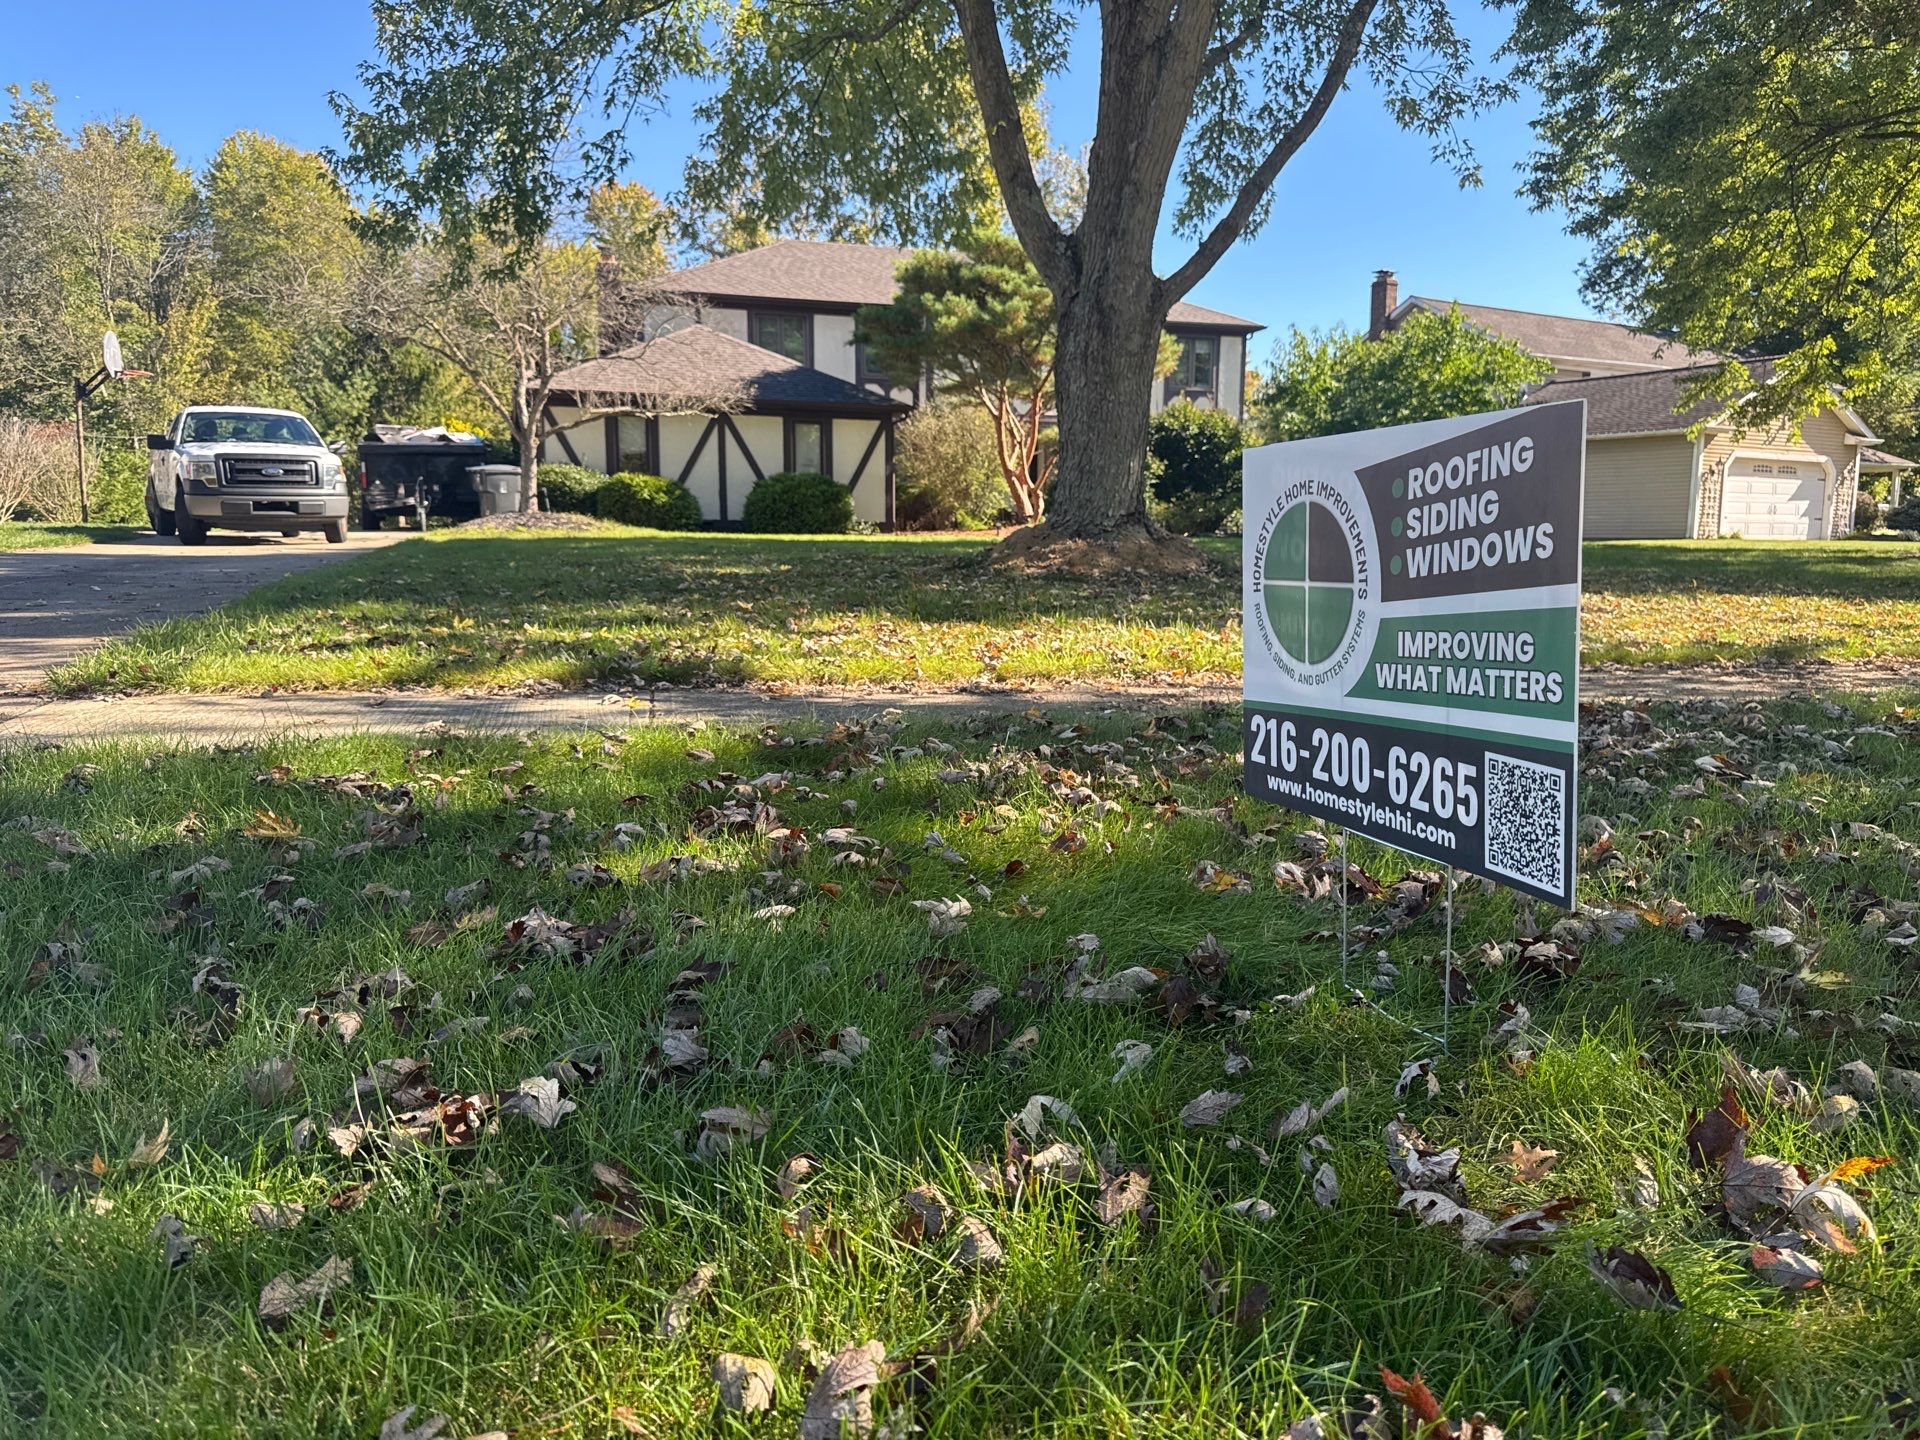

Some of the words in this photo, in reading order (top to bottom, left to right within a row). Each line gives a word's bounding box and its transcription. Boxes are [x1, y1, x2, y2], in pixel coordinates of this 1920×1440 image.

[1407, 436, 1534, 500] ROOFING
[1253, 496, 1285, 593] HOMESTYLE
[1284, 480, 1314, 504] HOME
[1316, 481, 1368, 600] IMPROVEMENTS
[1406, 490, 1499, 539] SIDING
[1406, 523, 1554, 579] WINDOWS
[1254, 603, 1273, 655] ROOFING,
[1273, 652, 1296, 682] SIDING,
[1298, 673, 1313, 686] AND
[1315, 660, 1344, 686] GUTTER
[1341, 610, 1366, 665] SYSTEMS
[1397, 631, 1535, 663] IMPROVING
[1375, 662, 1442, 691] WHAT
[1446, 667, 1563, 703] MATTERS
[1250, 714, 1479, 827] 216-200-6265
[1267, 775, 1456, 850] www.homestylehhi.com
